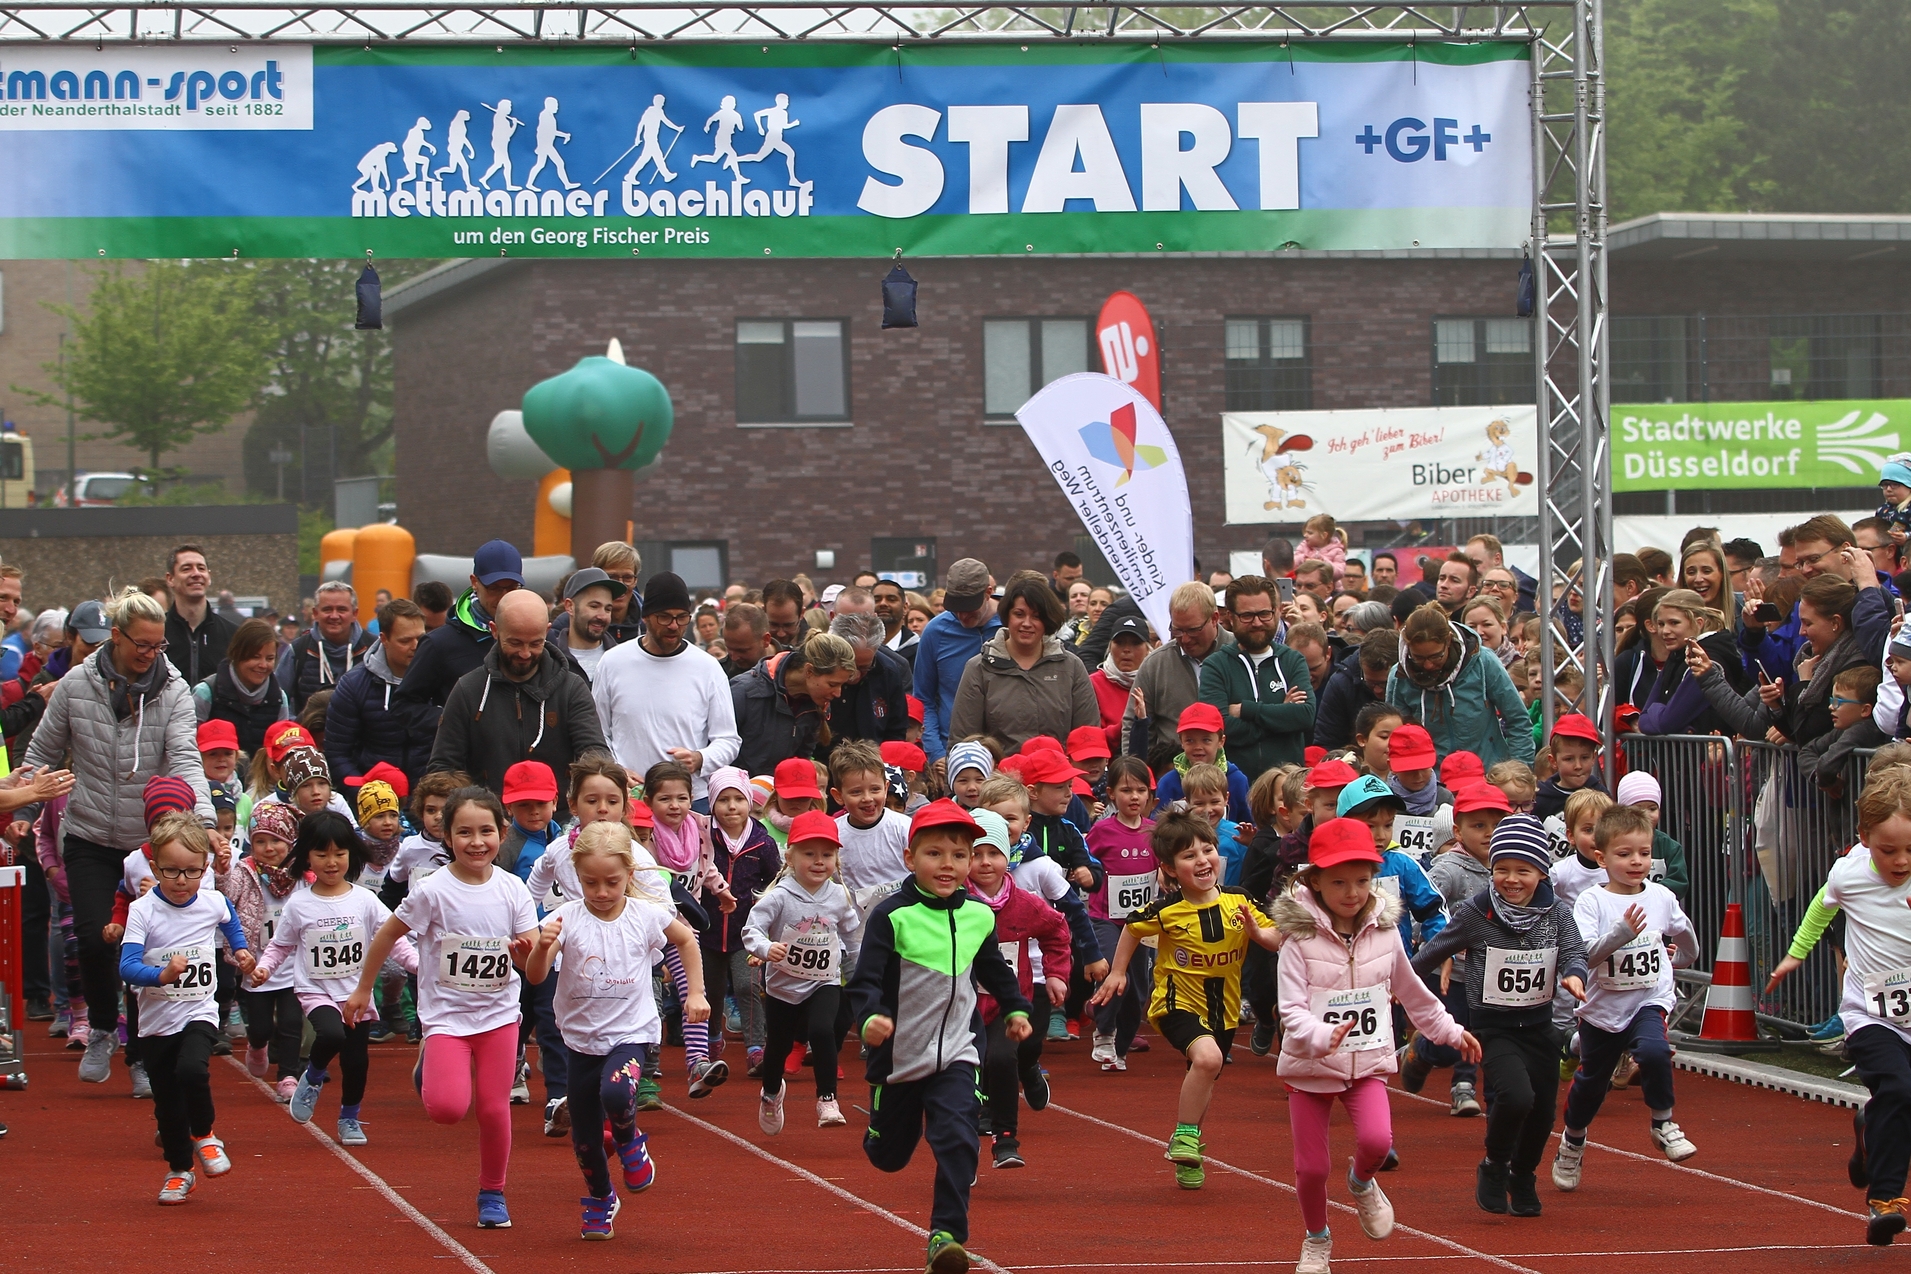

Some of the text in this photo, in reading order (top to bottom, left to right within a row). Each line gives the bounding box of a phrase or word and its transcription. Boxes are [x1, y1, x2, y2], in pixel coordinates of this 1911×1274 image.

[0, 60, 284, 111] mann-sport
[32, 103, 181, 117] Neanderthalstadt
[205, 104, 238, 117] seit
[244, 103, 284, 117] 1882
[1355, 117, 1491, 163] +GF+
[856, 101, 1319, 219] START
[351, 181, 814, 218] mettmanner bachlauf
[453, 226, 710, 248] um den Georg Fischer Preis
[1327, 437, 1347, 454] Ich
[1375, 427, 1405, 443] lieber
[1622, 412, 1802, 442] Stadtwerke
[1383, 427, 1445, 461] zum Biber!
[1412, 463, 1477, 486] Biber
[1624, 447, 1802, 479] Düsseldorf
[1431, 489, 1503, 504] APOTHEKE
[1547, 831, 1577, 858] 59
[1118, 886, 1151, 909] 650
[317, 915, 356, 929] CHERRY
[311, 941, 363, 968] 1348
[446, 951, 509, 979] 1428
[787, 944, 830, 970] 598
[1605, 948, 1660, 978] 1435
[1497, 967, 1546, 993] 654
[1872, 987, 1911, 1018] 13
